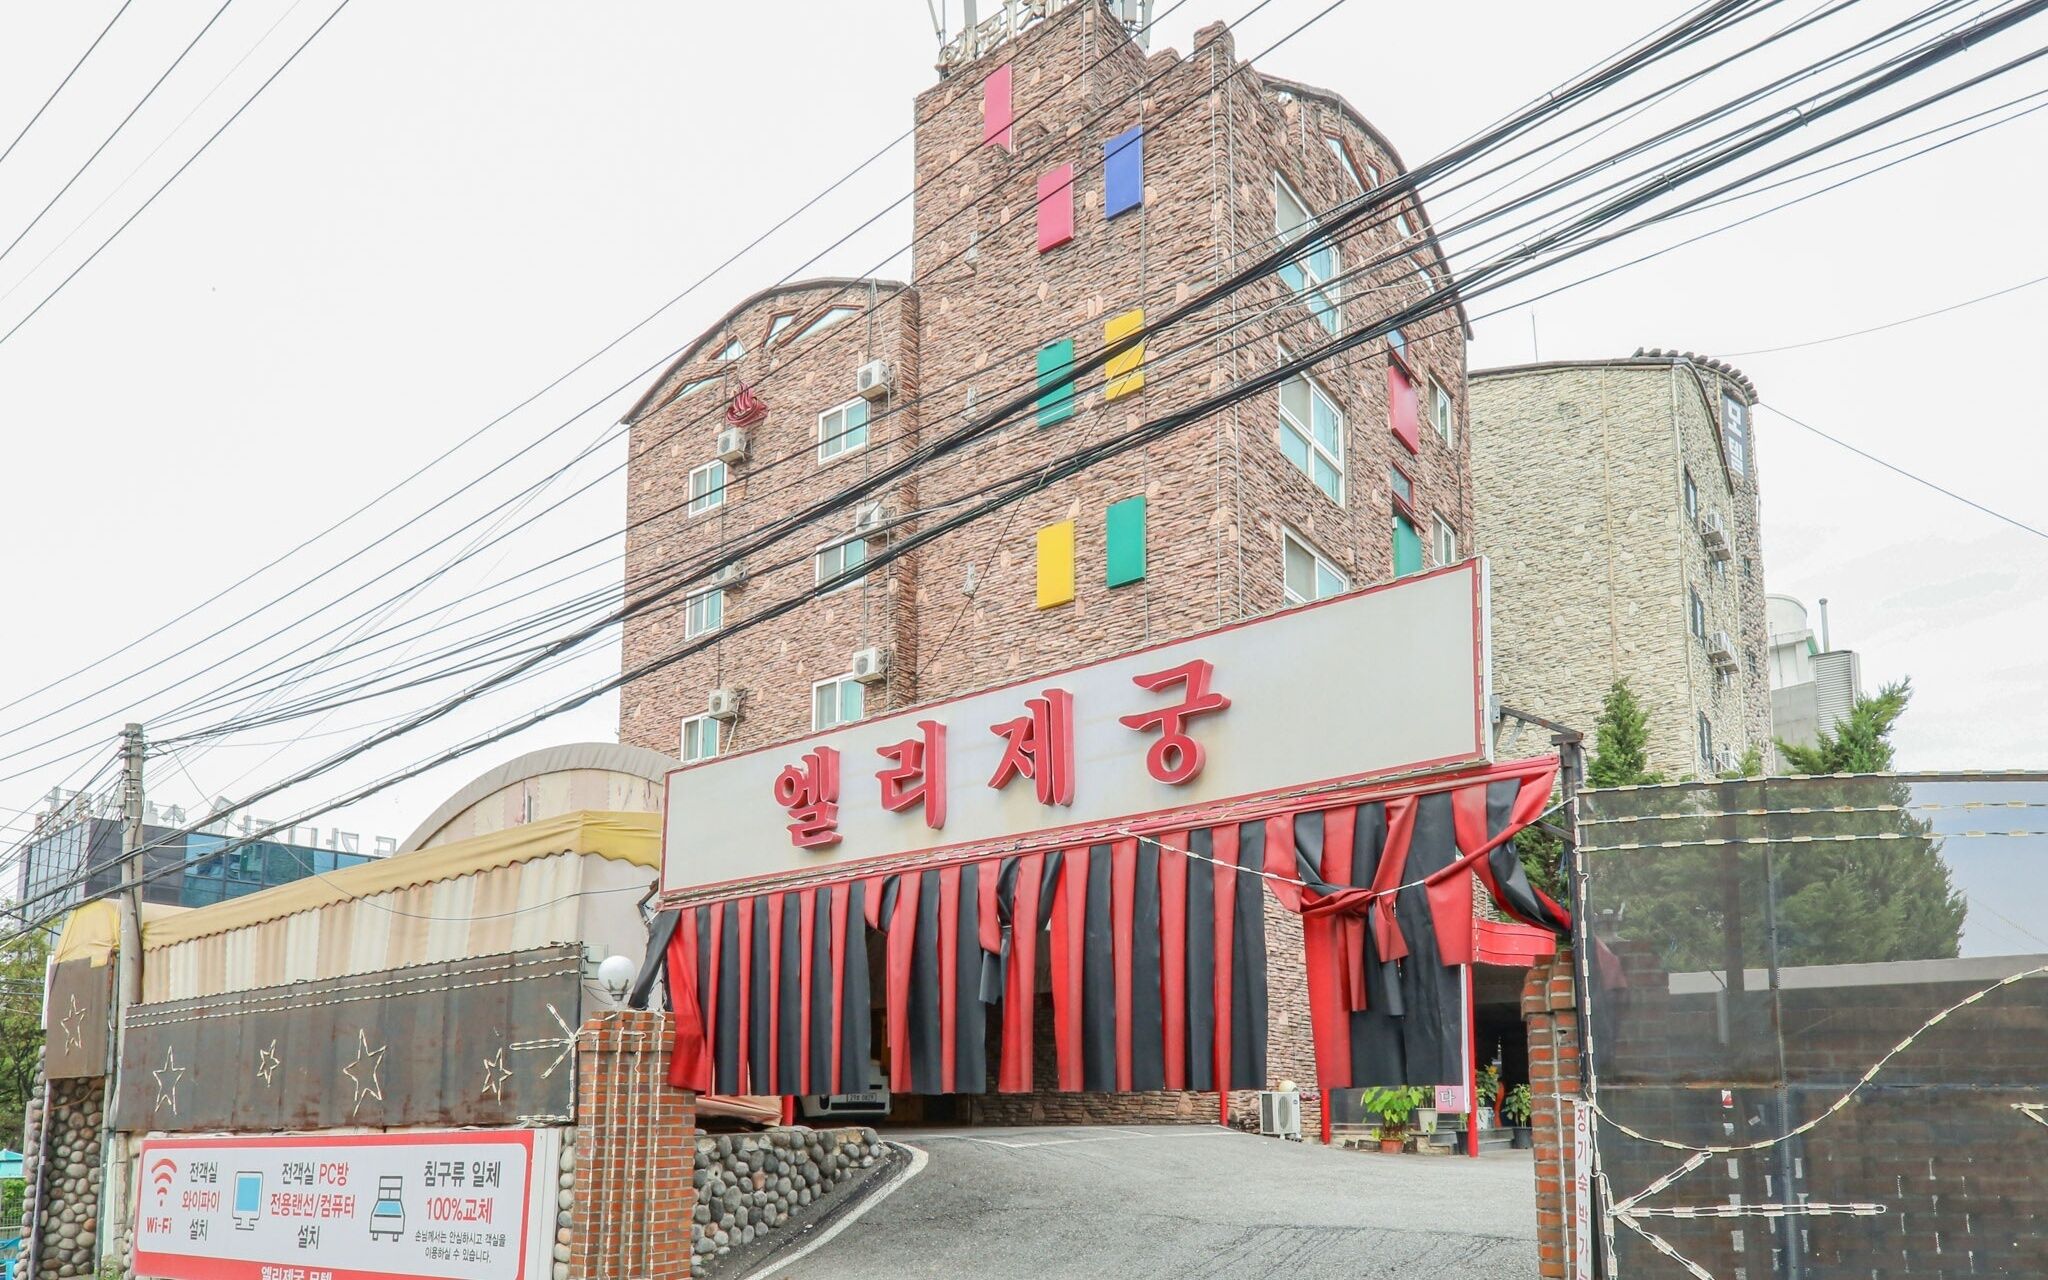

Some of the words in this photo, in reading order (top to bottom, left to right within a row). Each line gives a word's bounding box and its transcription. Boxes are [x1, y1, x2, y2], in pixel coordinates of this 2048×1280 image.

[774, 658, 1232, 849] 엘리제궁
[1439, 1088, 1457, 1107] 다
[190, 1161, 218, 1183] 전객실
[282, 1162, 315, 1186] 전객실
[319, 1161, 350, 1186] PC방
[424, 1160, 465, 1187] 침구류
[472, 1161, 501, 1188] 일체
[182, 1190, 220, 1213] 와이파이
[270, 1192, 356, 1219] 전용랜선/컴퓨터
[427, 1197, 493, 1224] 100%교체
[146, 1217, 172, 1234] Wi-Fi
[189, 1219, 208, 1241] 설치
[298, 1225, 320, 1250] 설치
[449, 1230, 482, 1245] 안심하시고
[485, 1233, 506, 1247] 객실을
[425, 1246, 451, 1260] 이용하실
[453, 1248, 460, 1260] 수
[462, 1248, 491, 1263] 있습니다.
